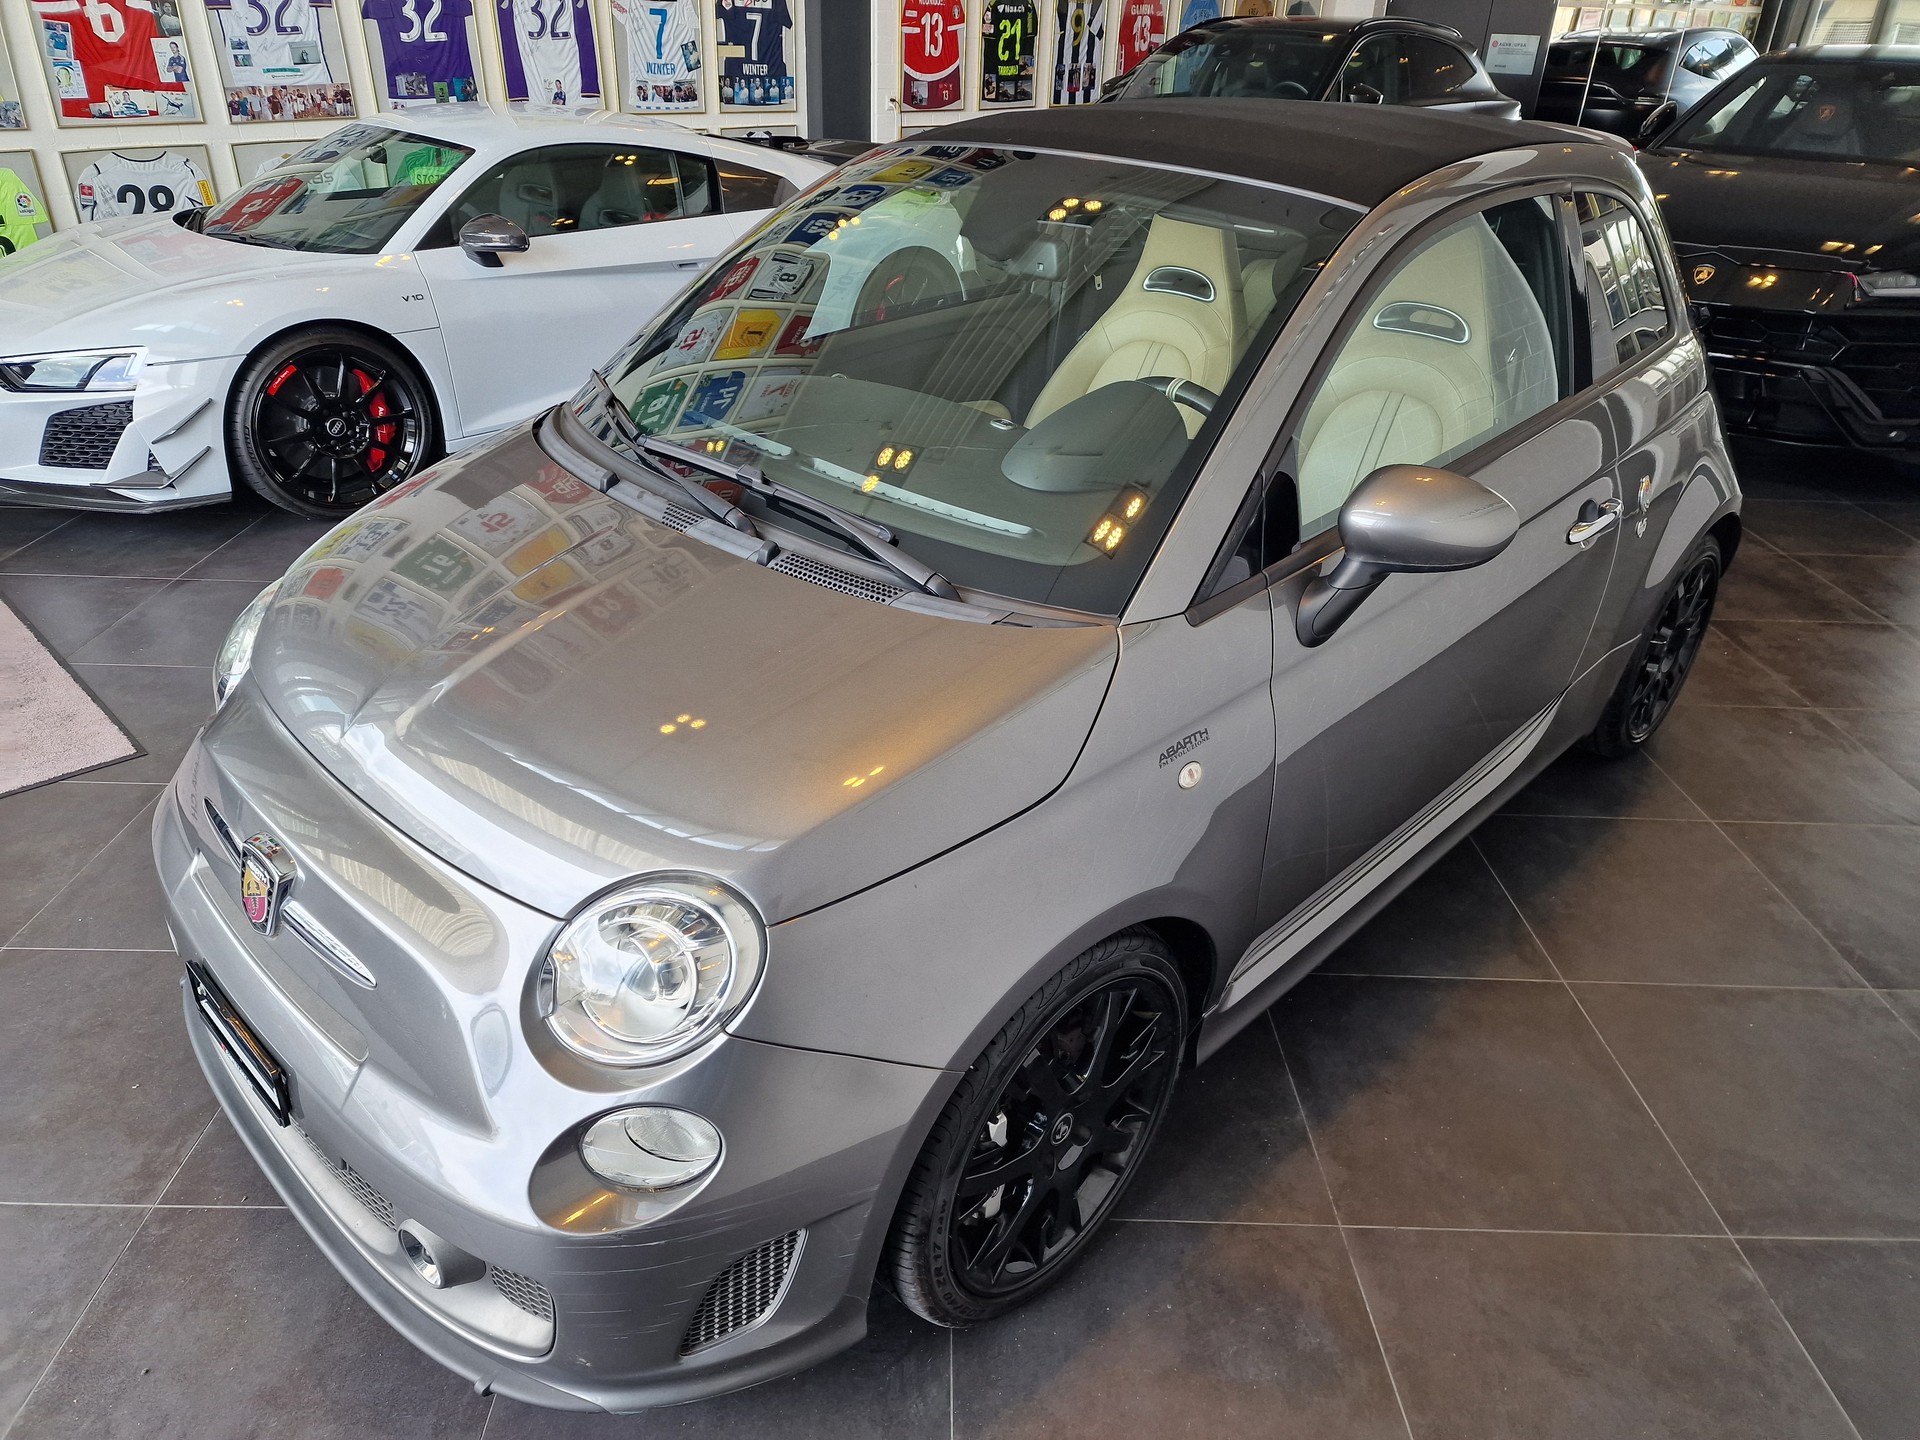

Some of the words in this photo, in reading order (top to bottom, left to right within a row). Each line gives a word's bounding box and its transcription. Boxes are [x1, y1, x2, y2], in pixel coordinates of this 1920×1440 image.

[649, 8, 668, 60] 7
[746, 12, 762, 61] 7
[920, 12, 943, 57] 13
[998, 18, 1022, 61] 21
[1071, 8, 1086, 47] 9
[1132, 15, 1152, 53] 13
[646, 62, 676, 76] WINTER
[742, 63, 769, 76] WINTER
[116, 184, 175, 214] 28
[1158, 728, 1209, 764] ABARTH
[1170, 736, 1210, 763] EVOLUZIONE
